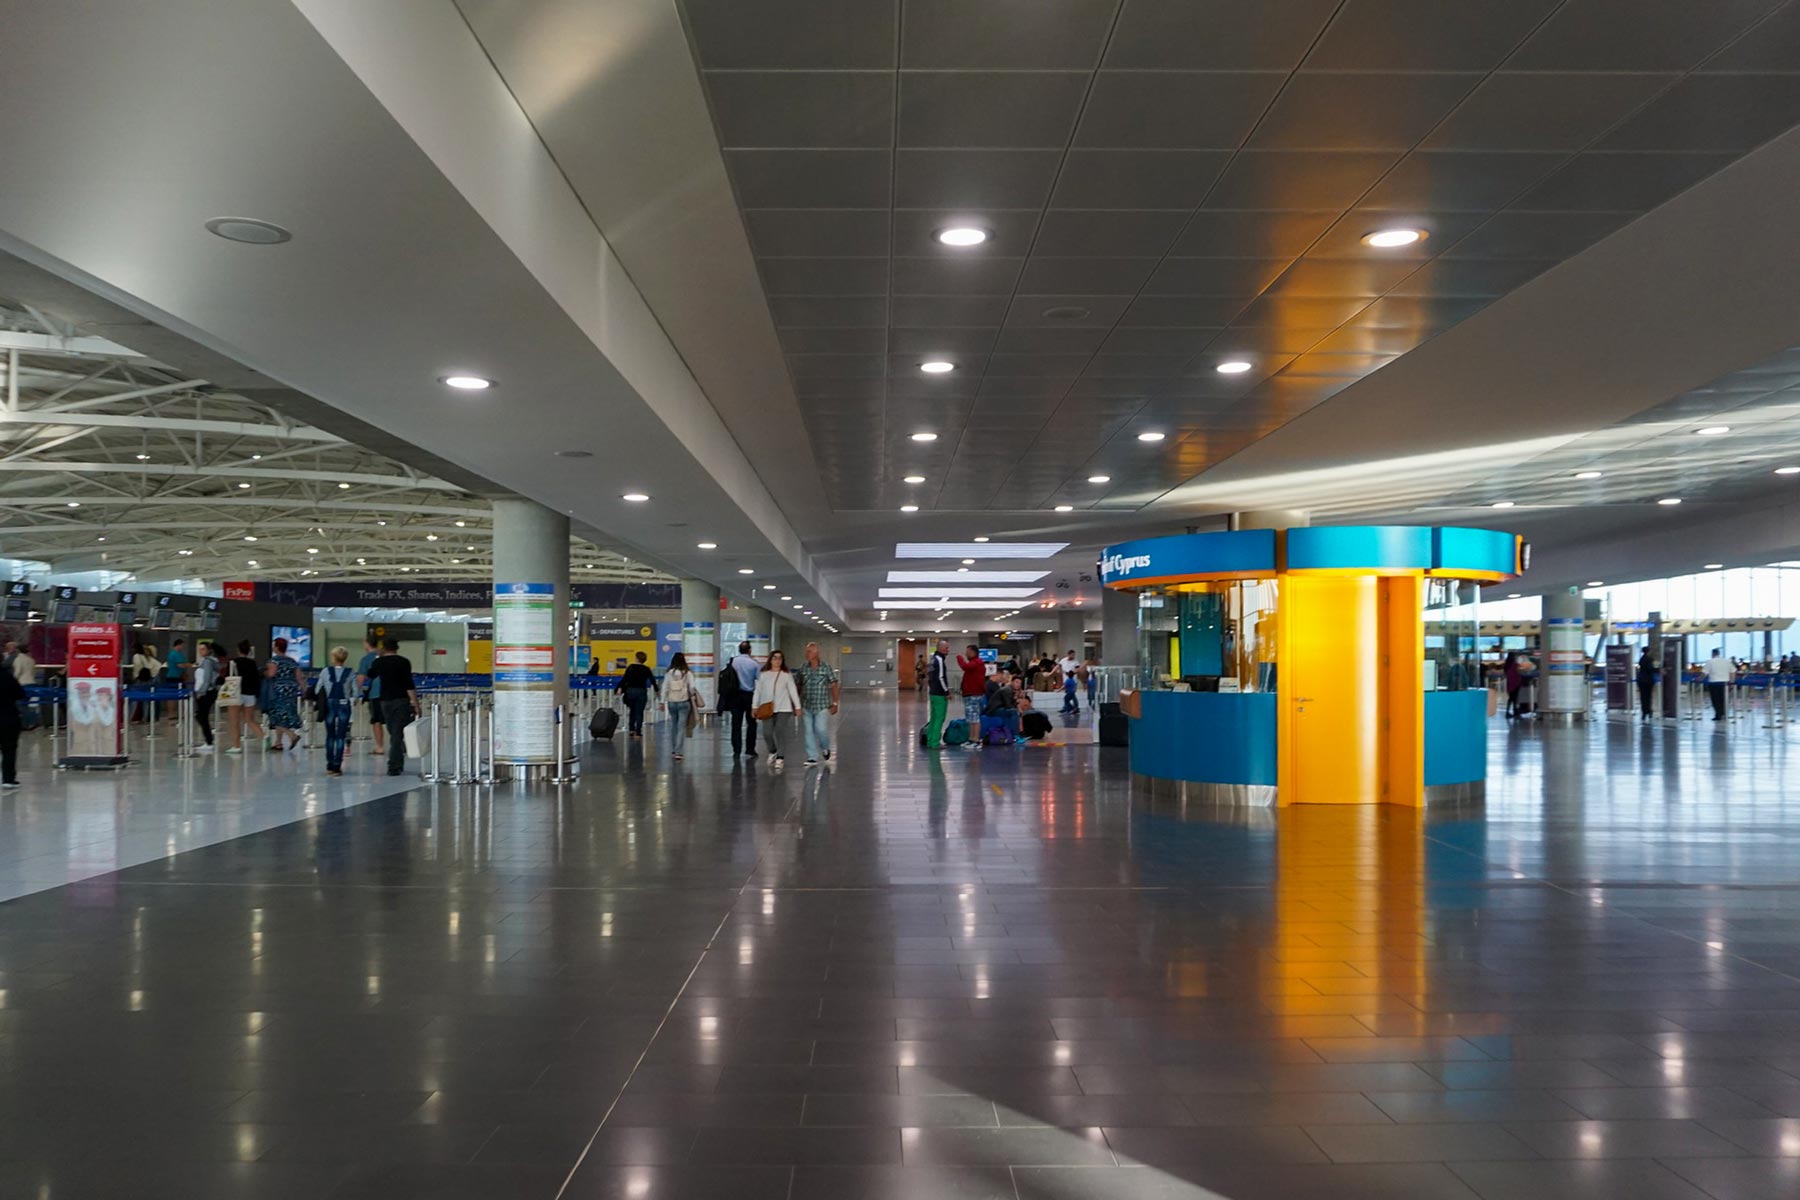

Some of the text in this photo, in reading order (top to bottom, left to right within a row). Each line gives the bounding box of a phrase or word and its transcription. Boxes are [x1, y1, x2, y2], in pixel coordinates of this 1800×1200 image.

[1115, 554, 1150, 575] Cyprus
[225, 587, 252, 597] FxPro
[357, 590, 386, 600] Trade
[408, 590, 443, 601] Shares,
[446, 590, 484, 601] Indices,
